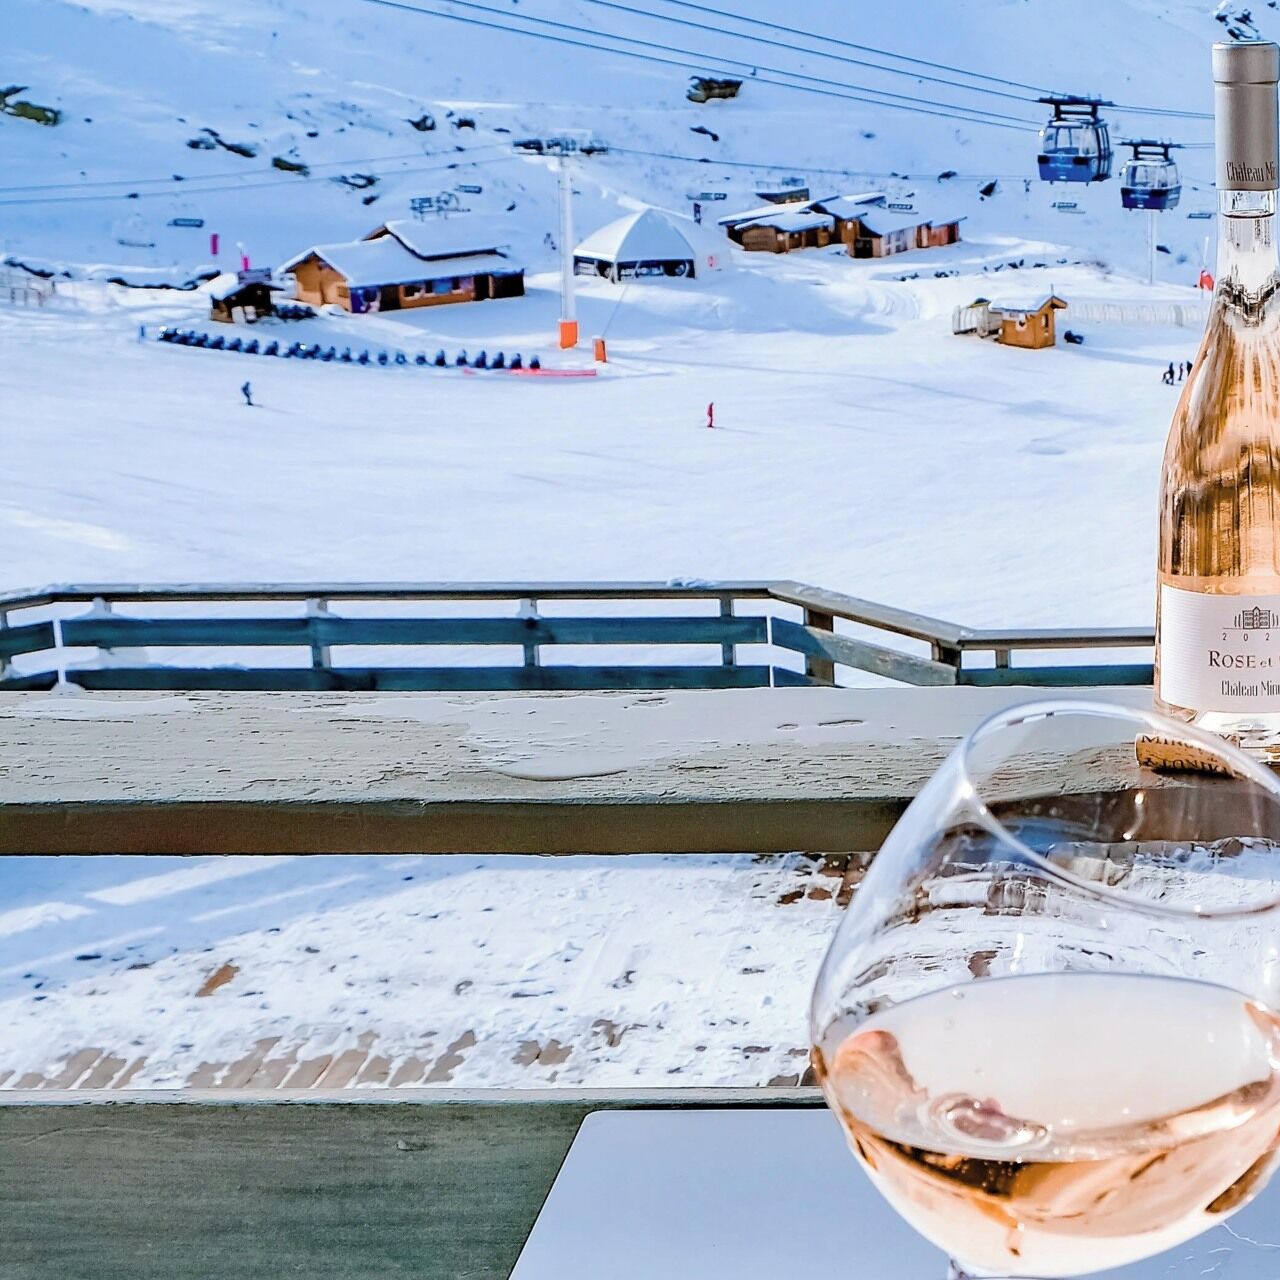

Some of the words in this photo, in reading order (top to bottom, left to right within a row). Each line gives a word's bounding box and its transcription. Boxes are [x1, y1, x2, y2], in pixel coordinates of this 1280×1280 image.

[1208, 649, 1256, 668] ROSE
[1260, 656, 1272, 667] et
[1221, 680, 1258, 696] Château
